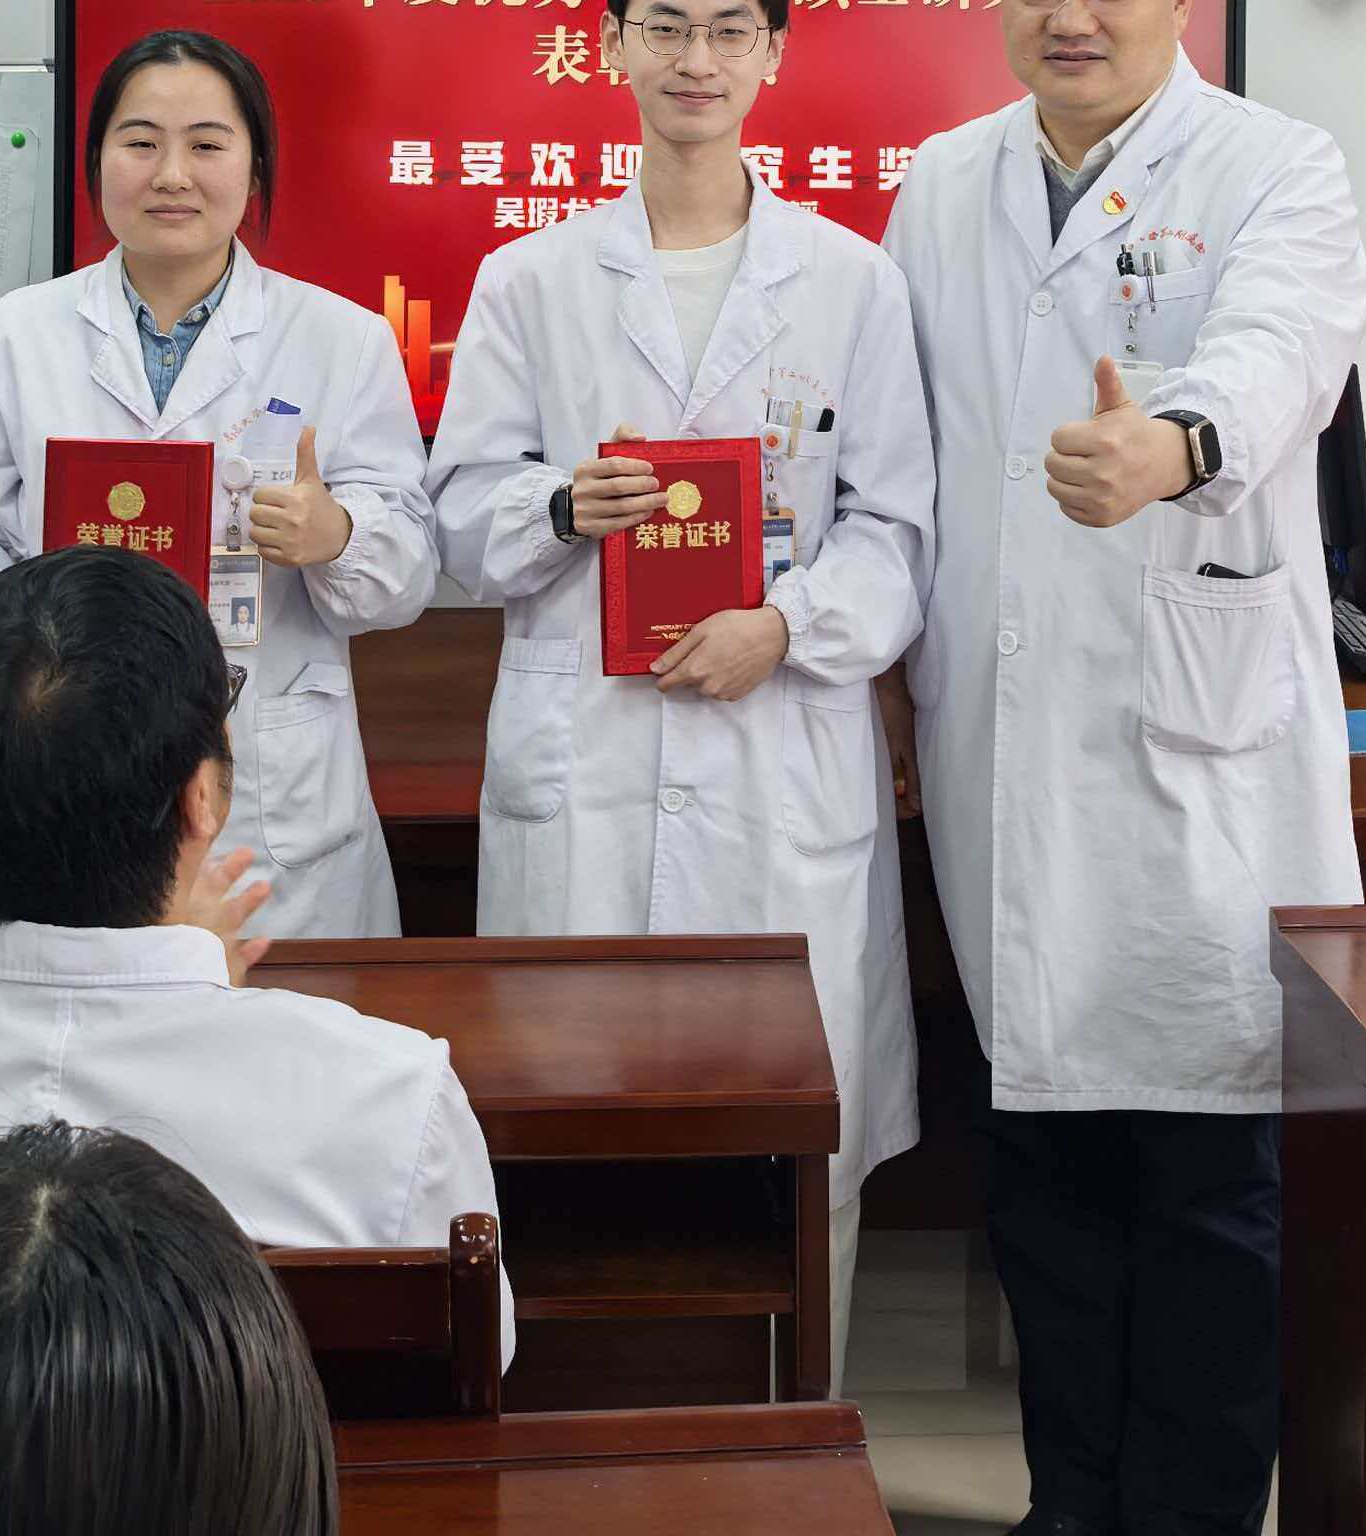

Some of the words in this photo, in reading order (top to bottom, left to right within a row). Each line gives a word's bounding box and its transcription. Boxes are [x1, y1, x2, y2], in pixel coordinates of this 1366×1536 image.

[76, 522, 174, 552] 荣誉证书
[635, 521, 731, 550] 荣誉证书
